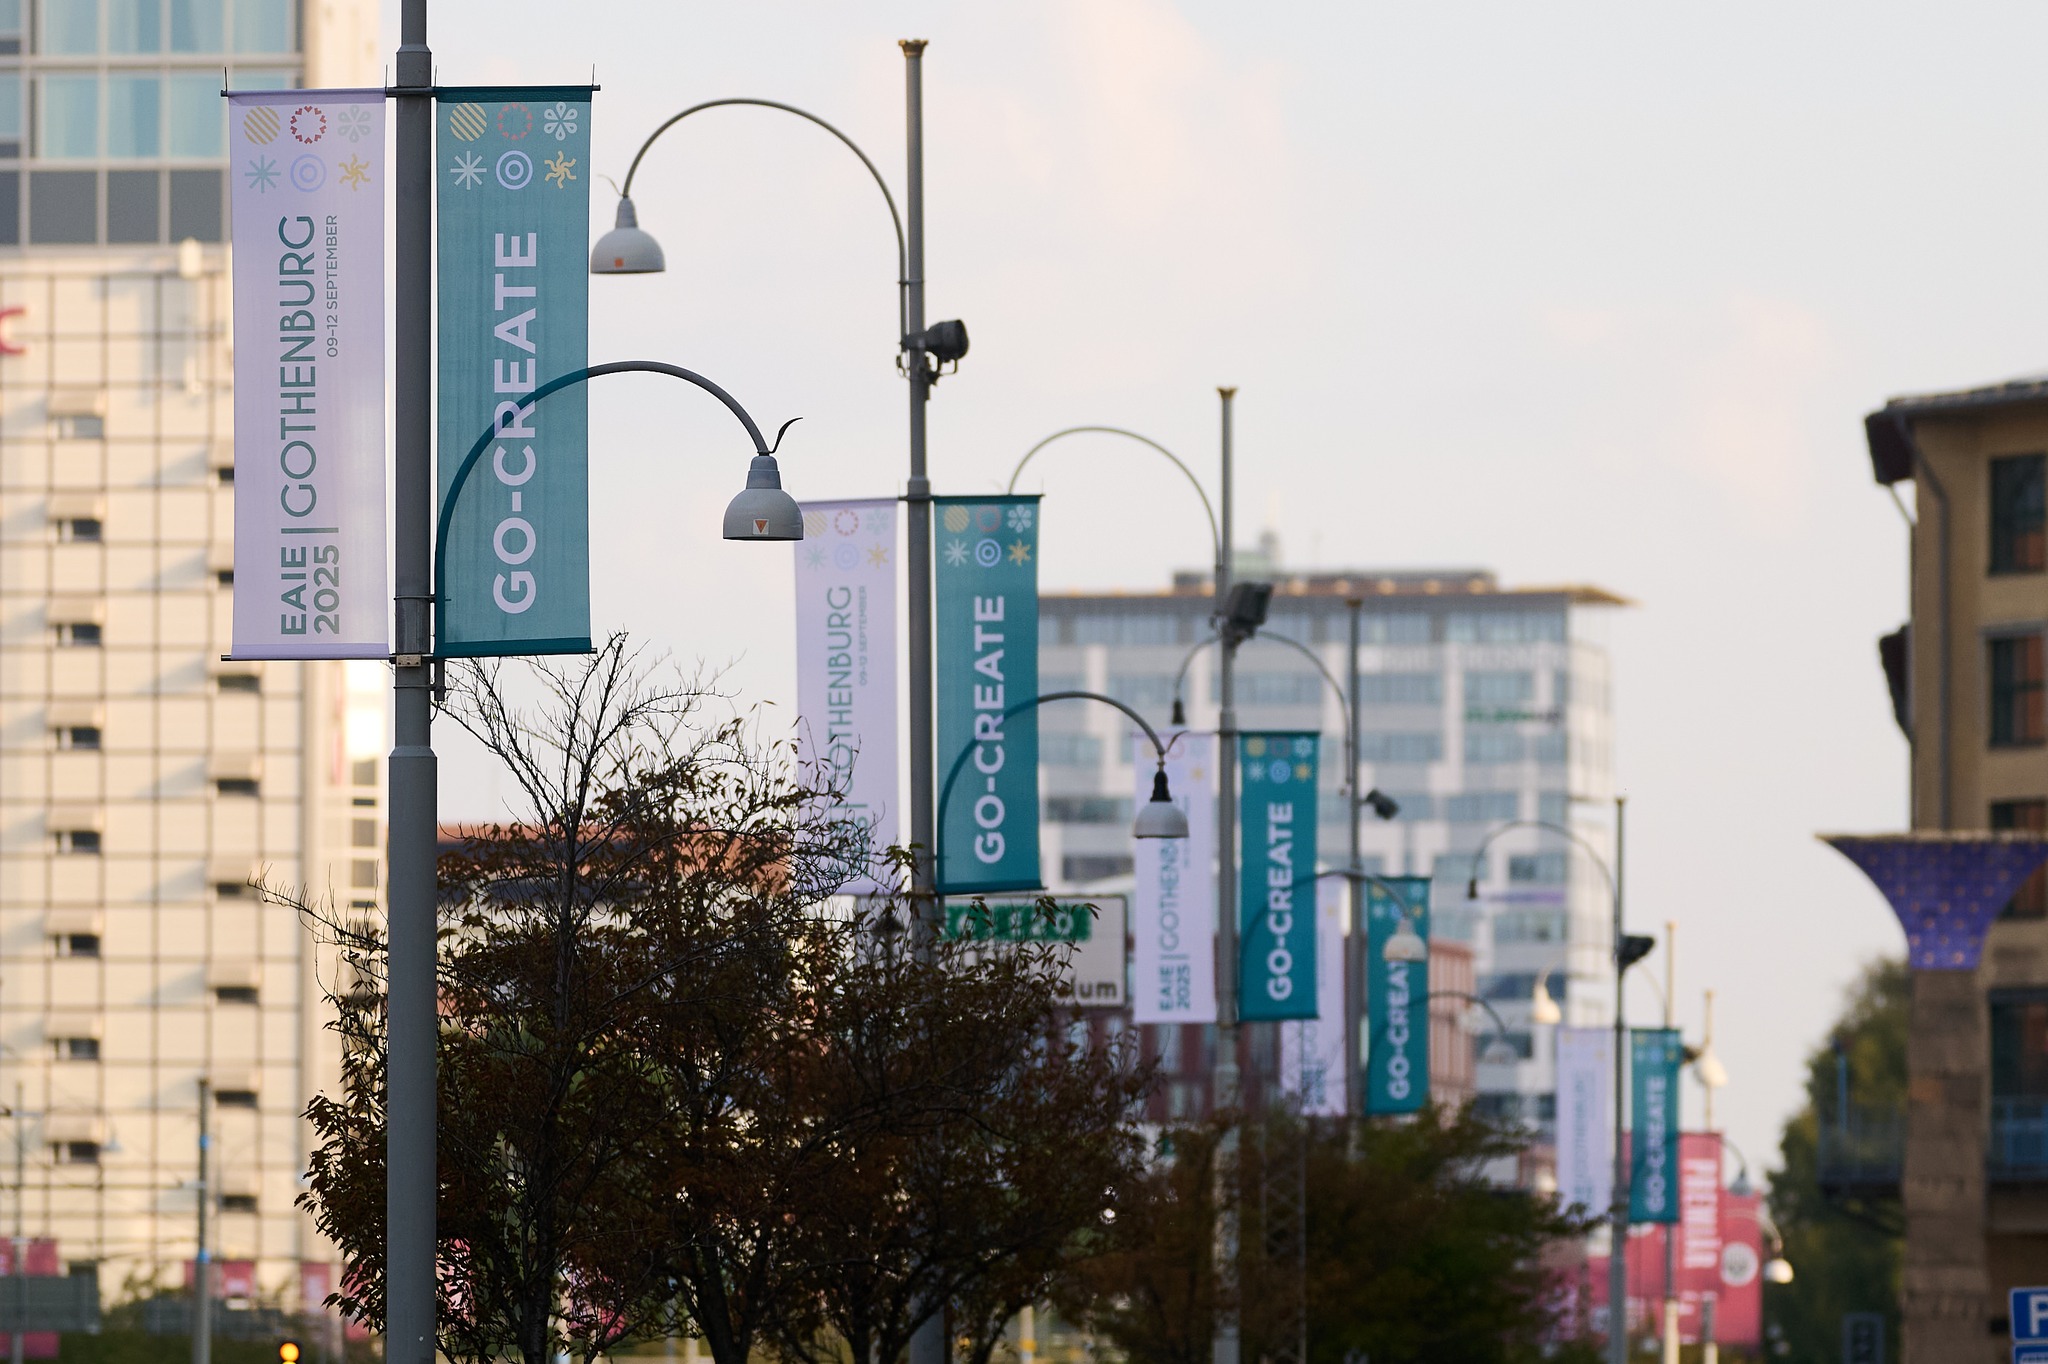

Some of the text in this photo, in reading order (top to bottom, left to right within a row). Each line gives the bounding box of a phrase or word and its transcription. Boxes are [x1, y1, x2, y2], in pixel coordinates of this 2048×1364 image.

[325, 215, 339, 309] SEPTEMBER
[278, 215, 317, 517] GOTHENBURG
[493, 232, 537, 614] GO-CREATE
[281, 546, 306, 635] EAIE
[314, 545, 340, 635] 2025
[859, 585, 868, 652] SEPTEMBER
[974, 595, 1006, 864] GO-CREATE
[1267, 802, 1293, 1001] GO-CREATE
[1158, 966, 1174, 1012] EAIE
[1177, 965, 1191, 1011] 2025
[1386, 961, 1410, 1100] GO-CREA
